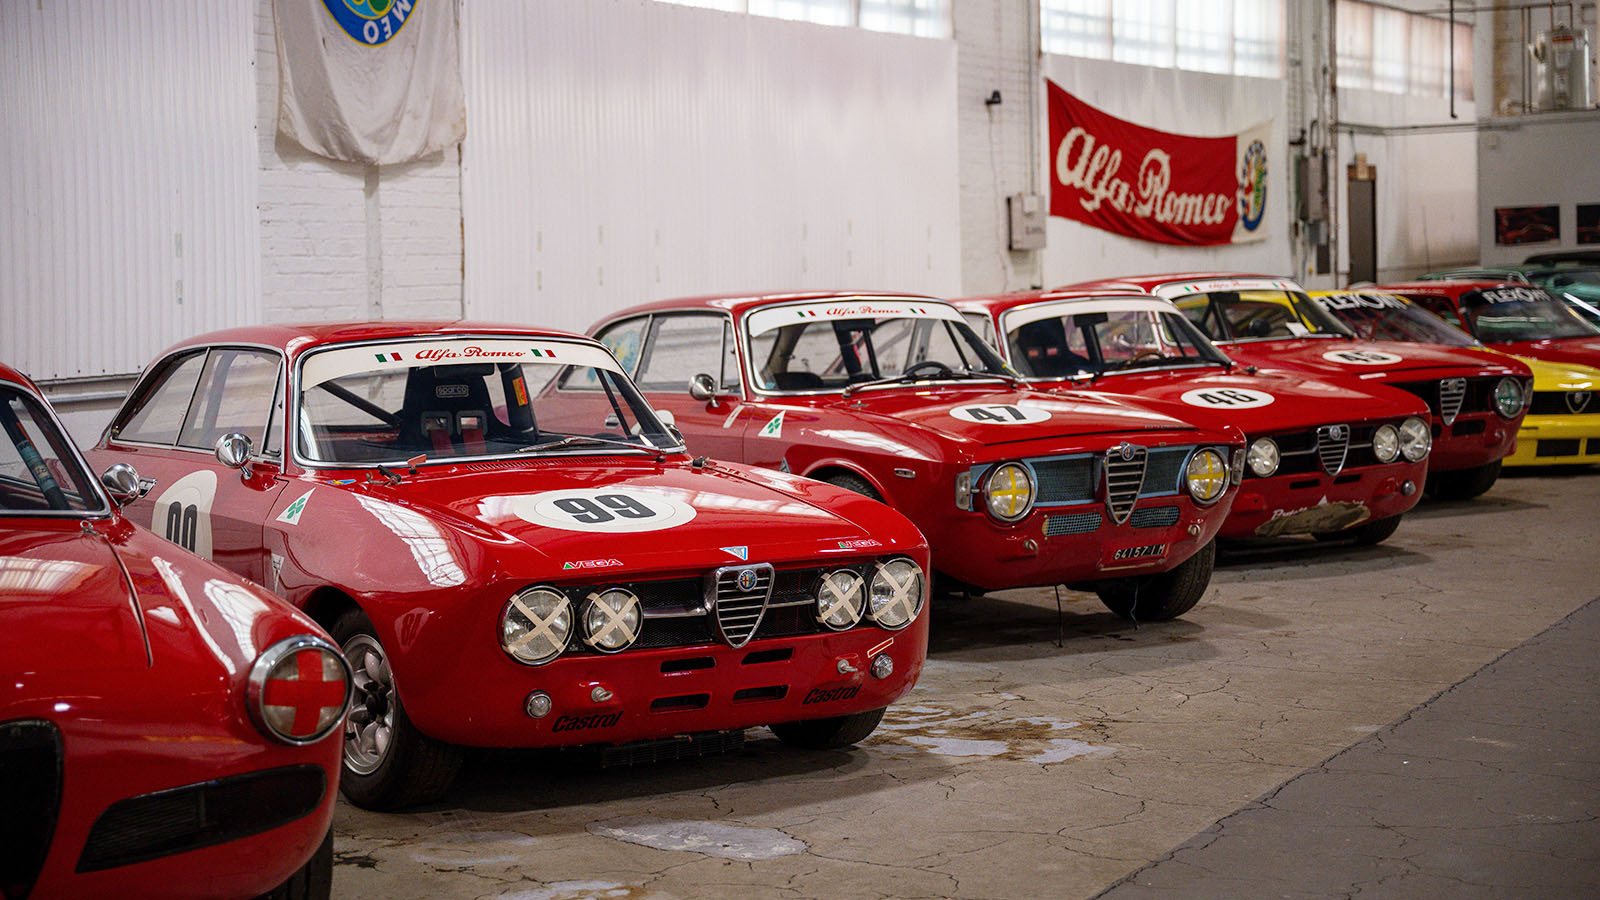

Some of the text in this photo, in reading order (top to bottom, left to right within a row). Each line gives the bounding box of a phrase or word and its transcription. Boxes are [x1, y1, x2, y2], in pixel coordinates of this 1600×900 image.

[1056, 126, 1135, 213] Alfa
[1137, 148, 1233, 225] Romeo
[826, 305, 902, 317] Alfa Romeo
[415, 346, 526, 362] Alfa Romeo
[1197, 390, 1259, 406] 46
[965, 405, 1027, 422] 47
[553, 494, 657, 524] 99
[839, 539, 882, 548] VEGA
[1114, 545, 1148, 560] 64157
[566, 558, 624, 569] VEGA
[803, 683, 863, 705] Castrol
[552, 711, 624, 733] Castrol
